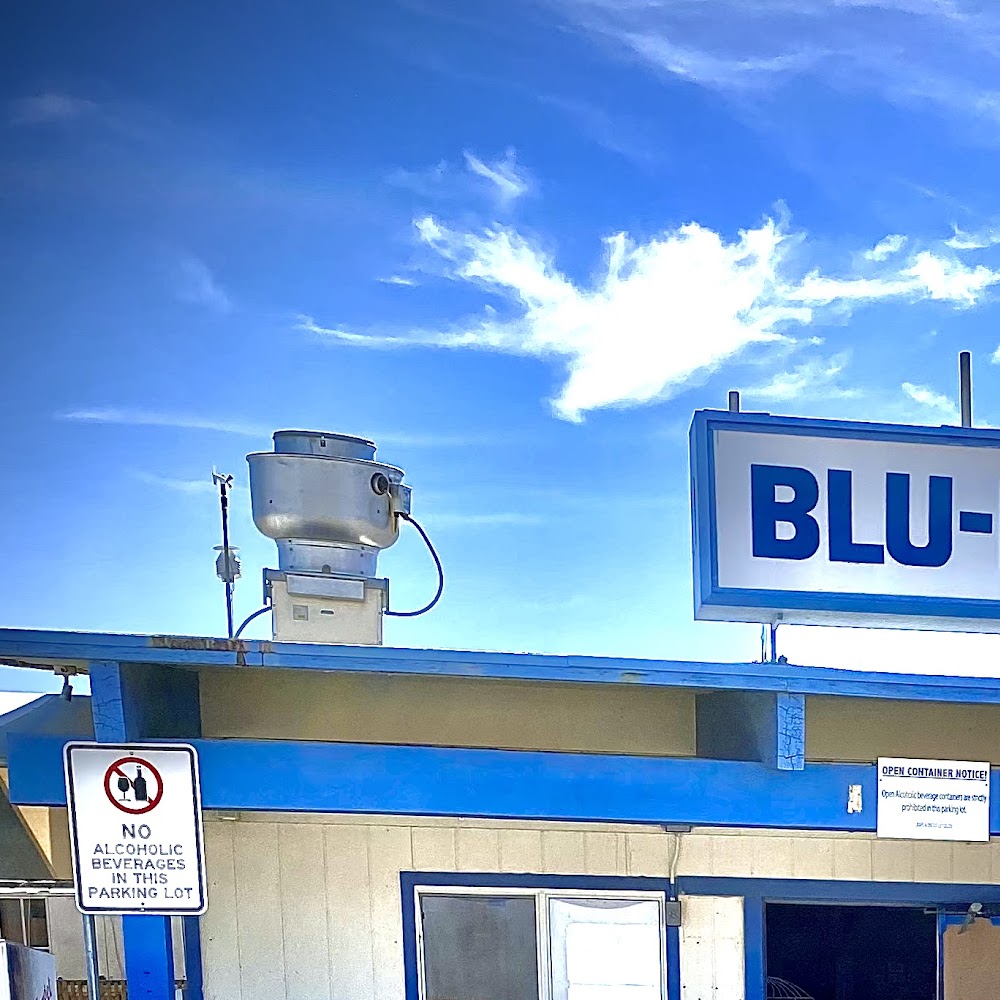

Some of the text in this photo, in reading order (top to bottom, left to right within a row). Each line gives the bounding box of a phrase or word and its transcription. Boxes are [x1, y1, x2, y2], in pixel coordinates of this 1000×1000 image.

[882, 766, 988, 780] OPEN CONTAINER NOTICE!
[881, 789, 895, 799] Open
[917, 791, 938, 802] beverage
[939, 793, 963, 802] containers
[121, 823, 152, 840] NO
[93, 843, 183, 856] ALCOHOLIC
[91, 858, 186, 870] BEVERAGES
[111, 872, 168, 884] IN THIS
[88, 886, 193, 900] PARKING LOT
